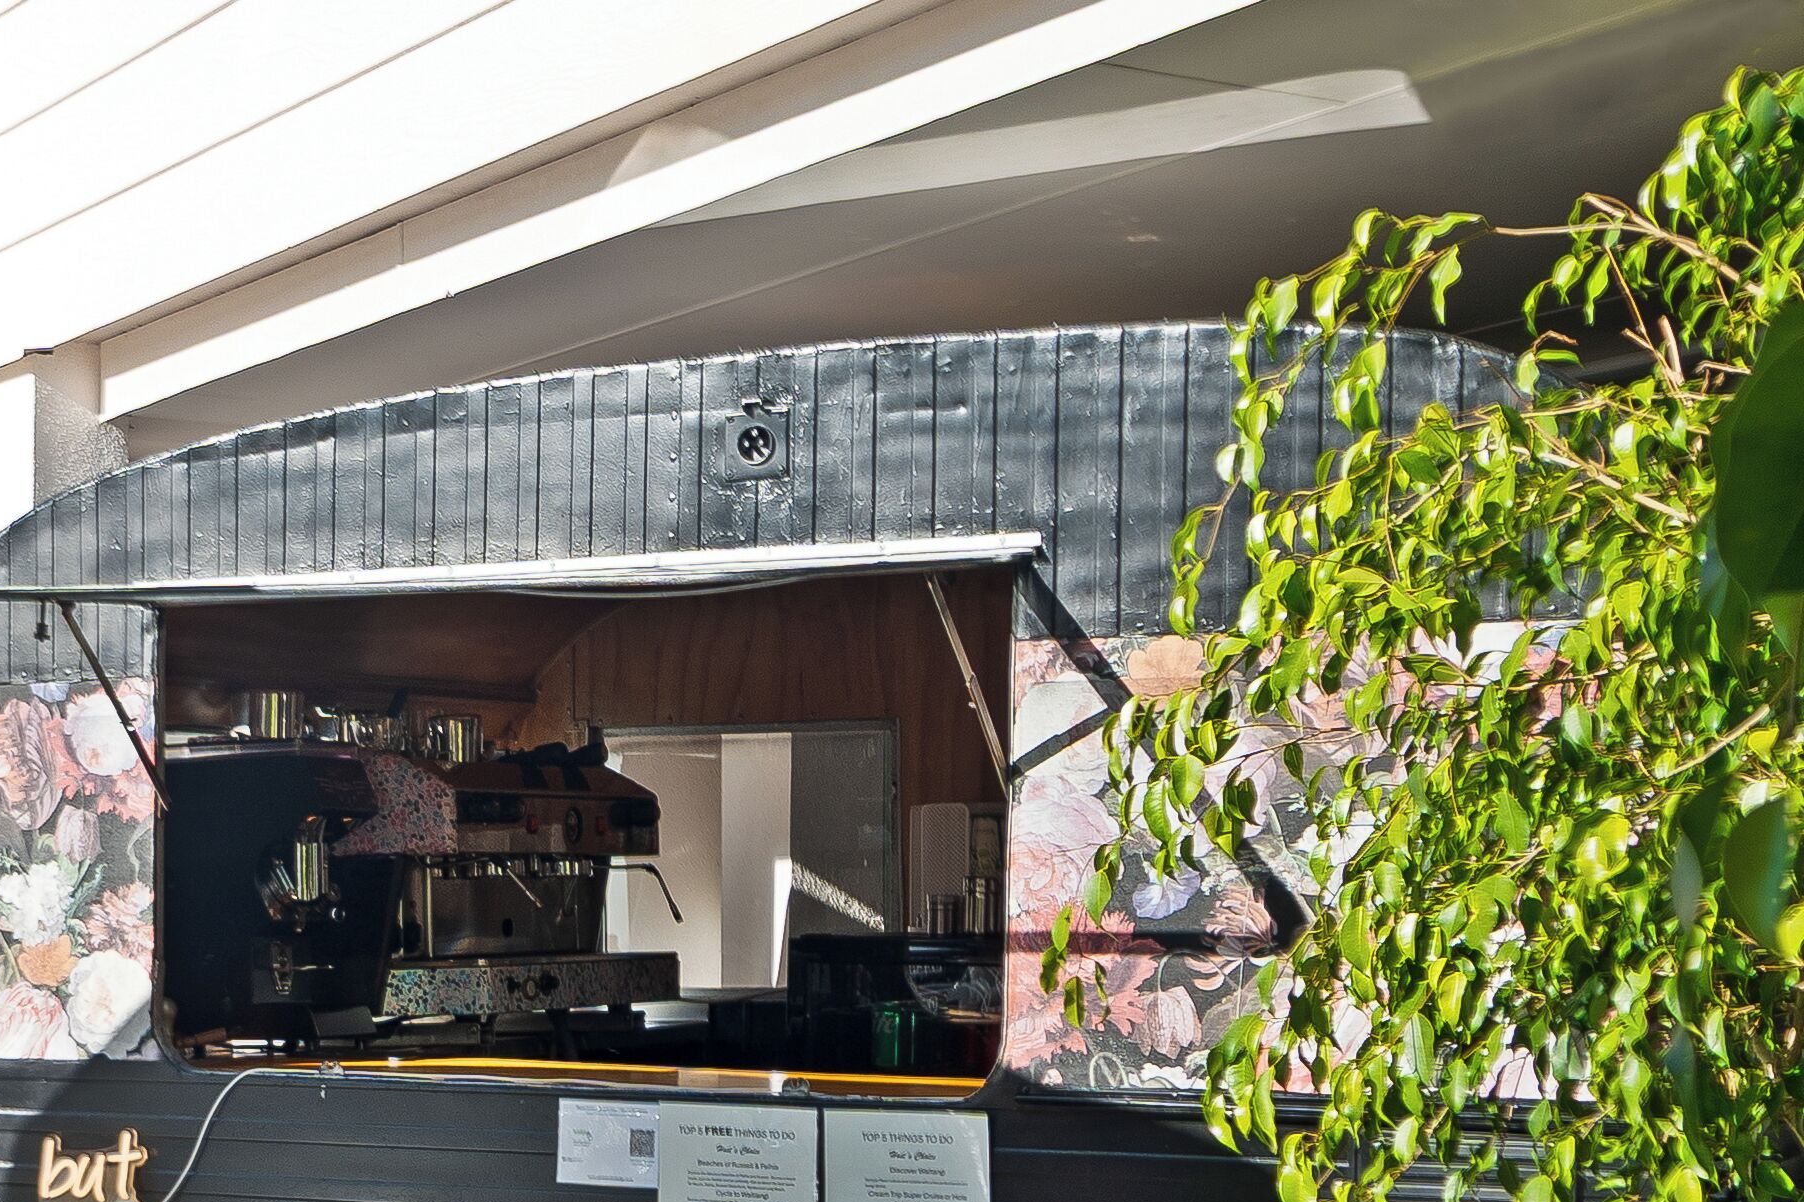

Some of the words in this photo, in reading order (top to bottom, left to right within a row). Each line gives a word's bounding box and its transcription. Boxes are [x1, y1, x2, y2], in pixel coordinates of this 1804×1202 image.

[679, 1124, 696, 1135] TOP
[704, 1125, 733, 1137] FREE
[734, 1128, 768, 1139] THINGS
[769, 1130, 780, 1140] TO
[782, 1130, 796, 1140] DO
[862, 1131, 881, 1142] TOP
[889, 1133, 924, 1144] THINGS
[925, 1134, 938, 1144] TO
[938, 1135, 954, 1145] DO
[39, 1128, 147, 1202] but
